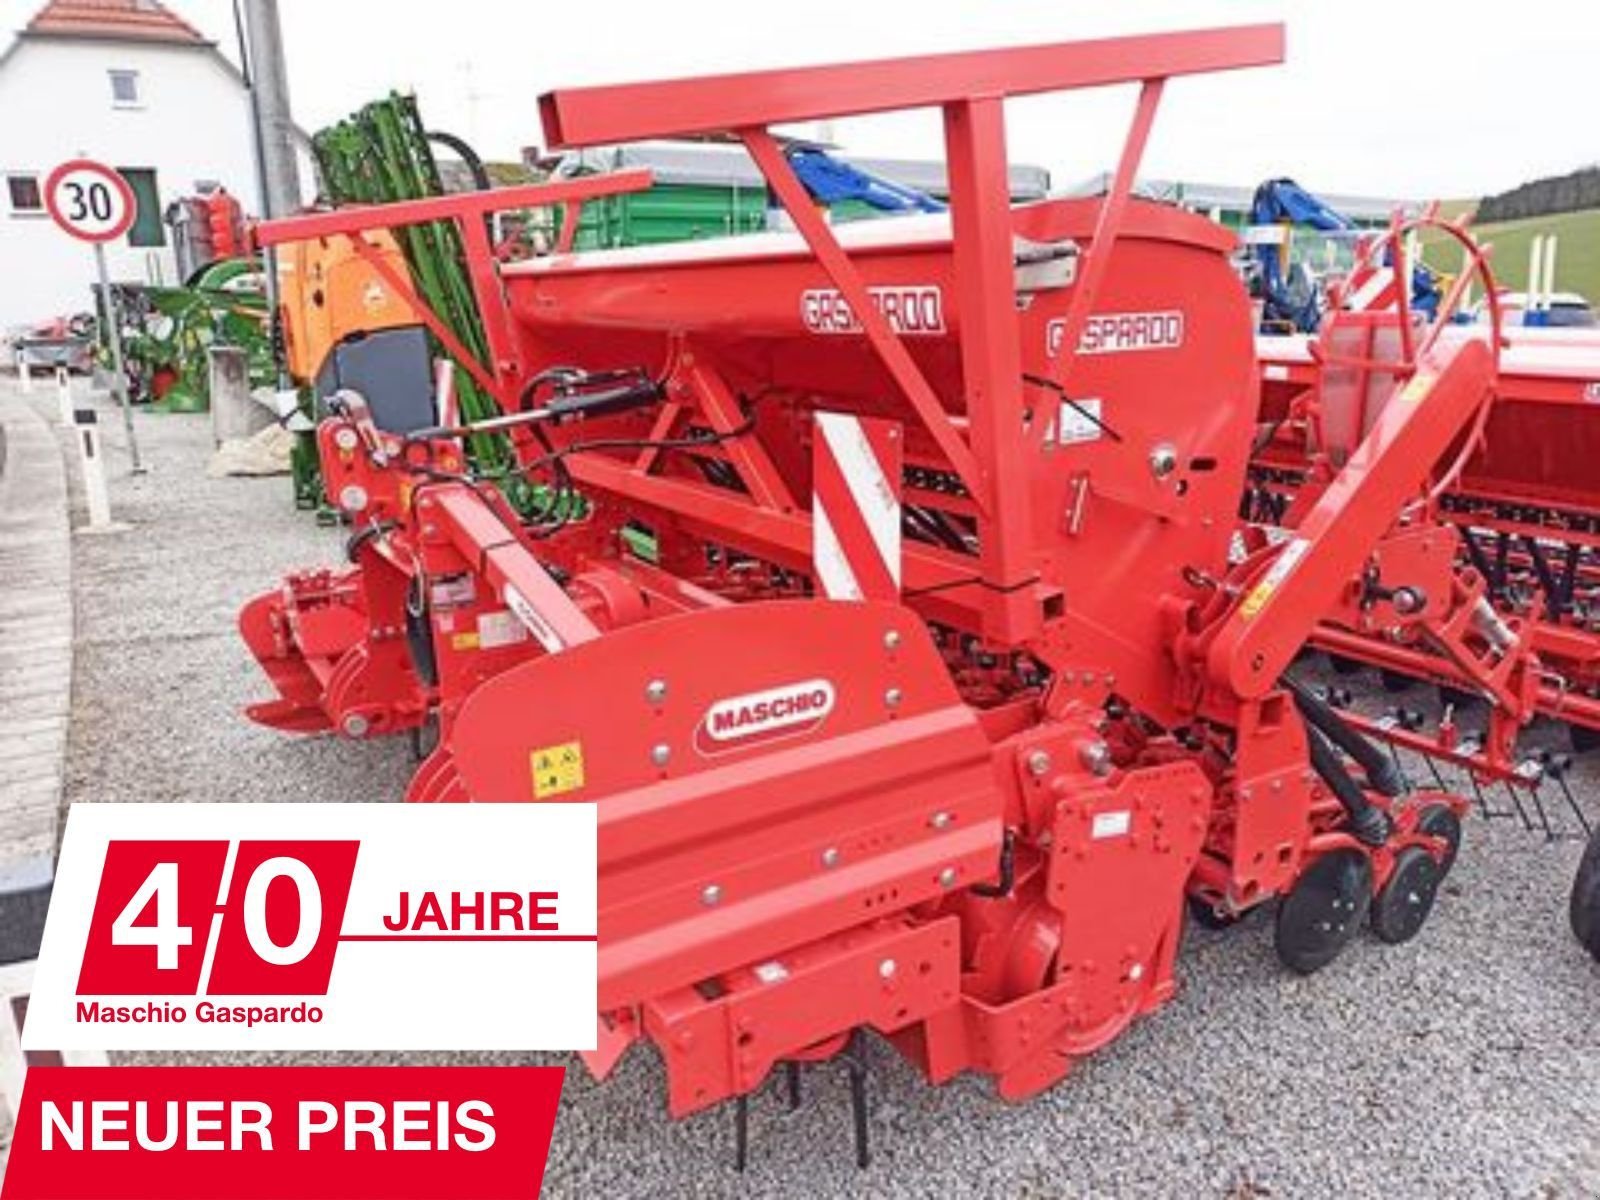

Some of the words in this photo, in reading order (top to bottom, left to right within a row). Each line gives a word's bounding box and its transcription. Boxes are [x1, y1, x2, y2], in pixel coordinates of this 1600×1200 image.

[64, 182, 111, 221] 30
[803, 291, 941, 331] GASRDO
[1050, 315, 1180, 351] GSPARDO
[713, 689, 827, 732] MASCHIO
